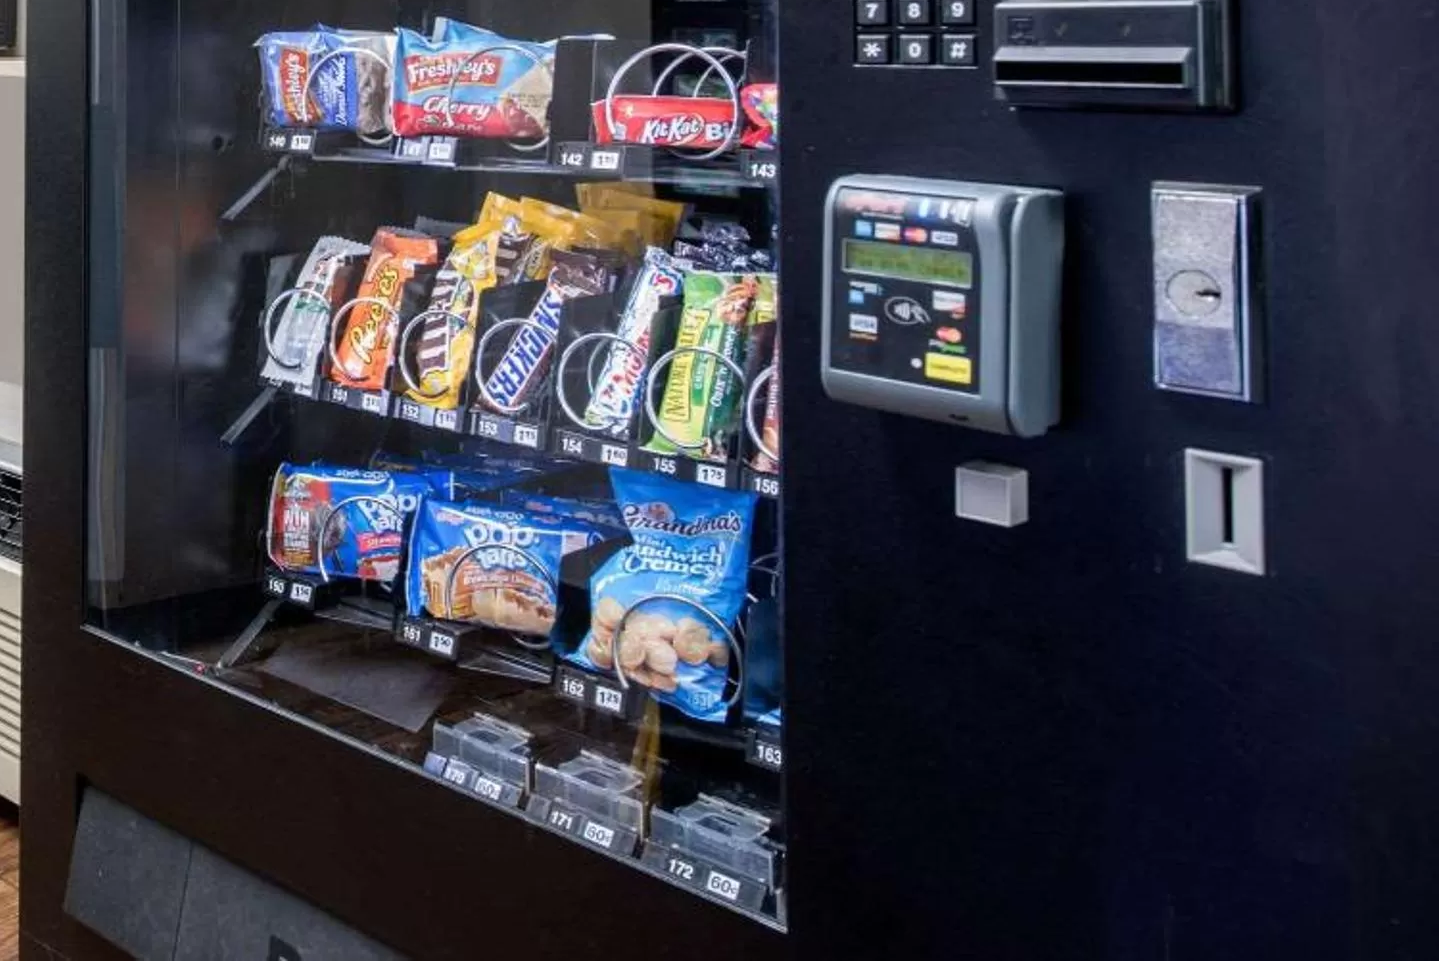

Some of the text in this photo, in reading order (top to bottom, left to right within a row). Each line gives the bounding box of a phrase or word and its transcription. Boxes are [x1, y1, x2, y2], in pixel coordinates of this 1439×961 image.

[865, 1, 965, 19] 7 8 9
[908, 41, 967, 59] 0 #
[561, 153, 584, 166] 142
[750, 164, 776, 178] 143
[487, 288, 563, 408] SNICKERS
[665, 363, 688, 418] NATURE
[479, 419, 498, 435] 153
[562, 438, 582, 454] 154
[654, 457, 676, 474] 155
[754, 478, 779, 495] 156
[623, 503, 741, 536] Grandma's
[562, 679, 584, 698] 162
[756, 745, 782, 765] 163
[552, 810, 573, 830] 171
[668, 858, 694, 880] 172
